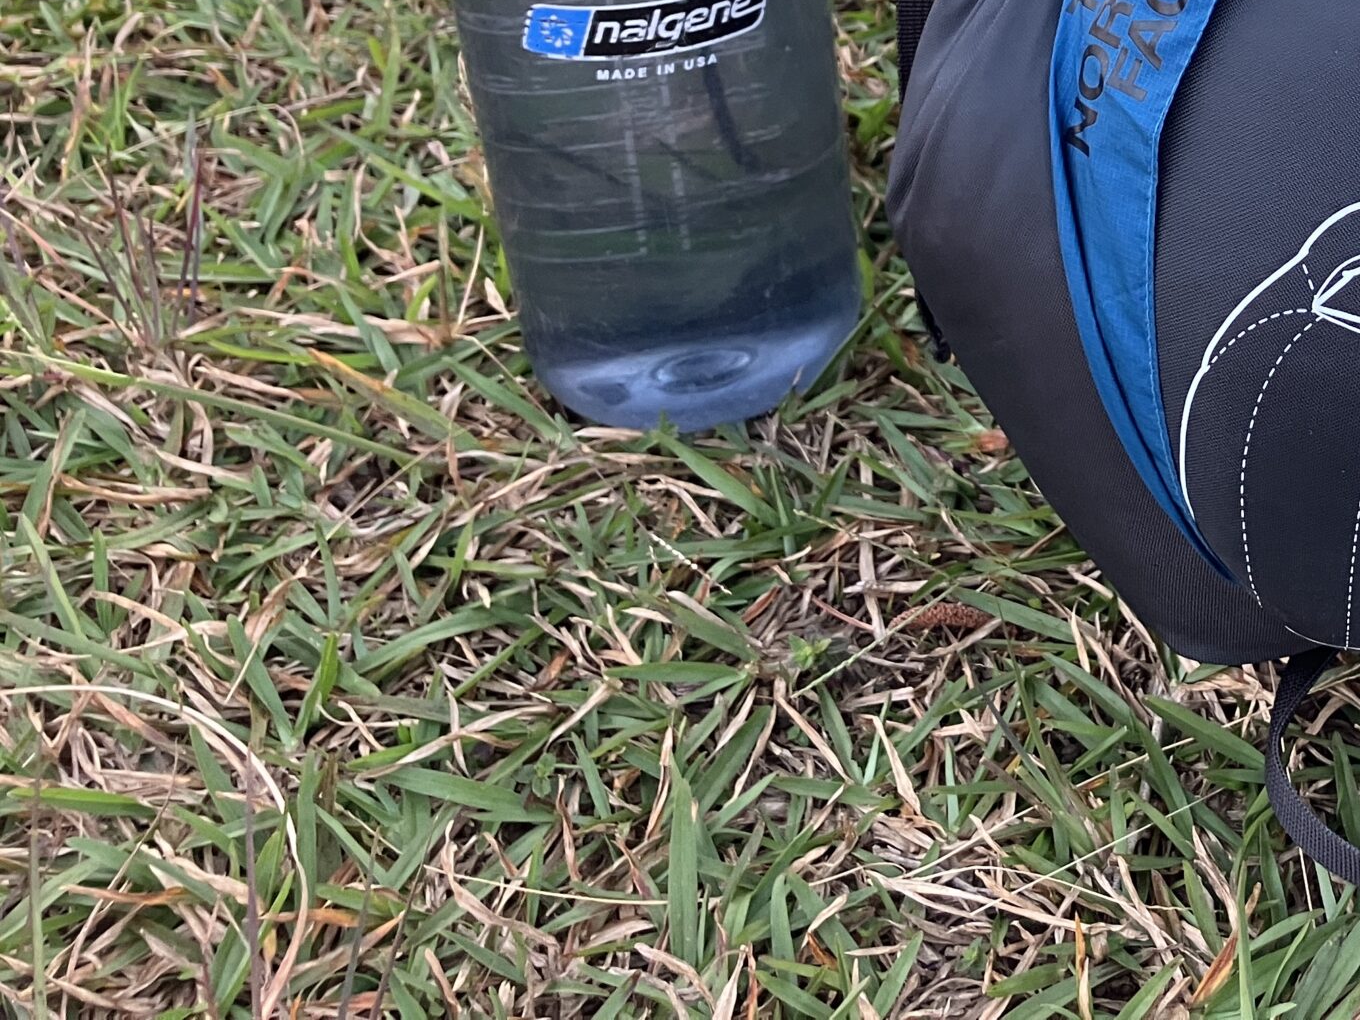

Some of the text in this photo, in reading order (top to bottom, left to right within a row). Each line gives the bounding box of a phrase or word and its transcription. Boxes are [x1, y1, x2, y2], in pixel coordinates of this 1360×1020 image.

[596, 53, 718, 80] MADE IN USA
